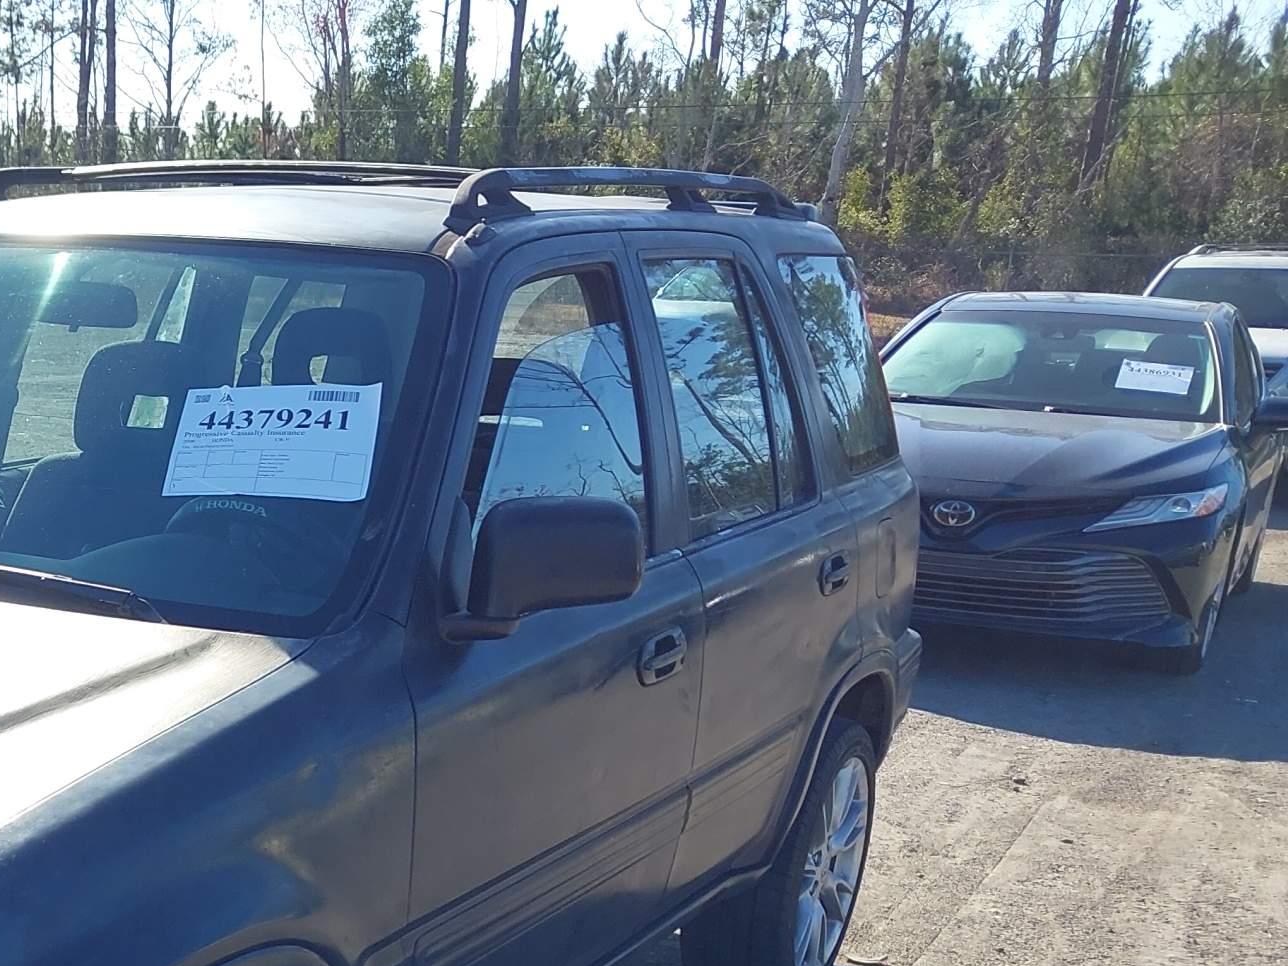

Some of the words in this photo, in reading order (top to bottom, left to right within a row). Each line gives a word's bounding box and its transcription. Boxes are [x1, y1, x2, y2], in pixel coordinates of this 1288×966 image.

[198, 408, 351, 431] 44379241
[184, 431, 229, 439] Progressive
[206, 499, 267, 517] HONDA
